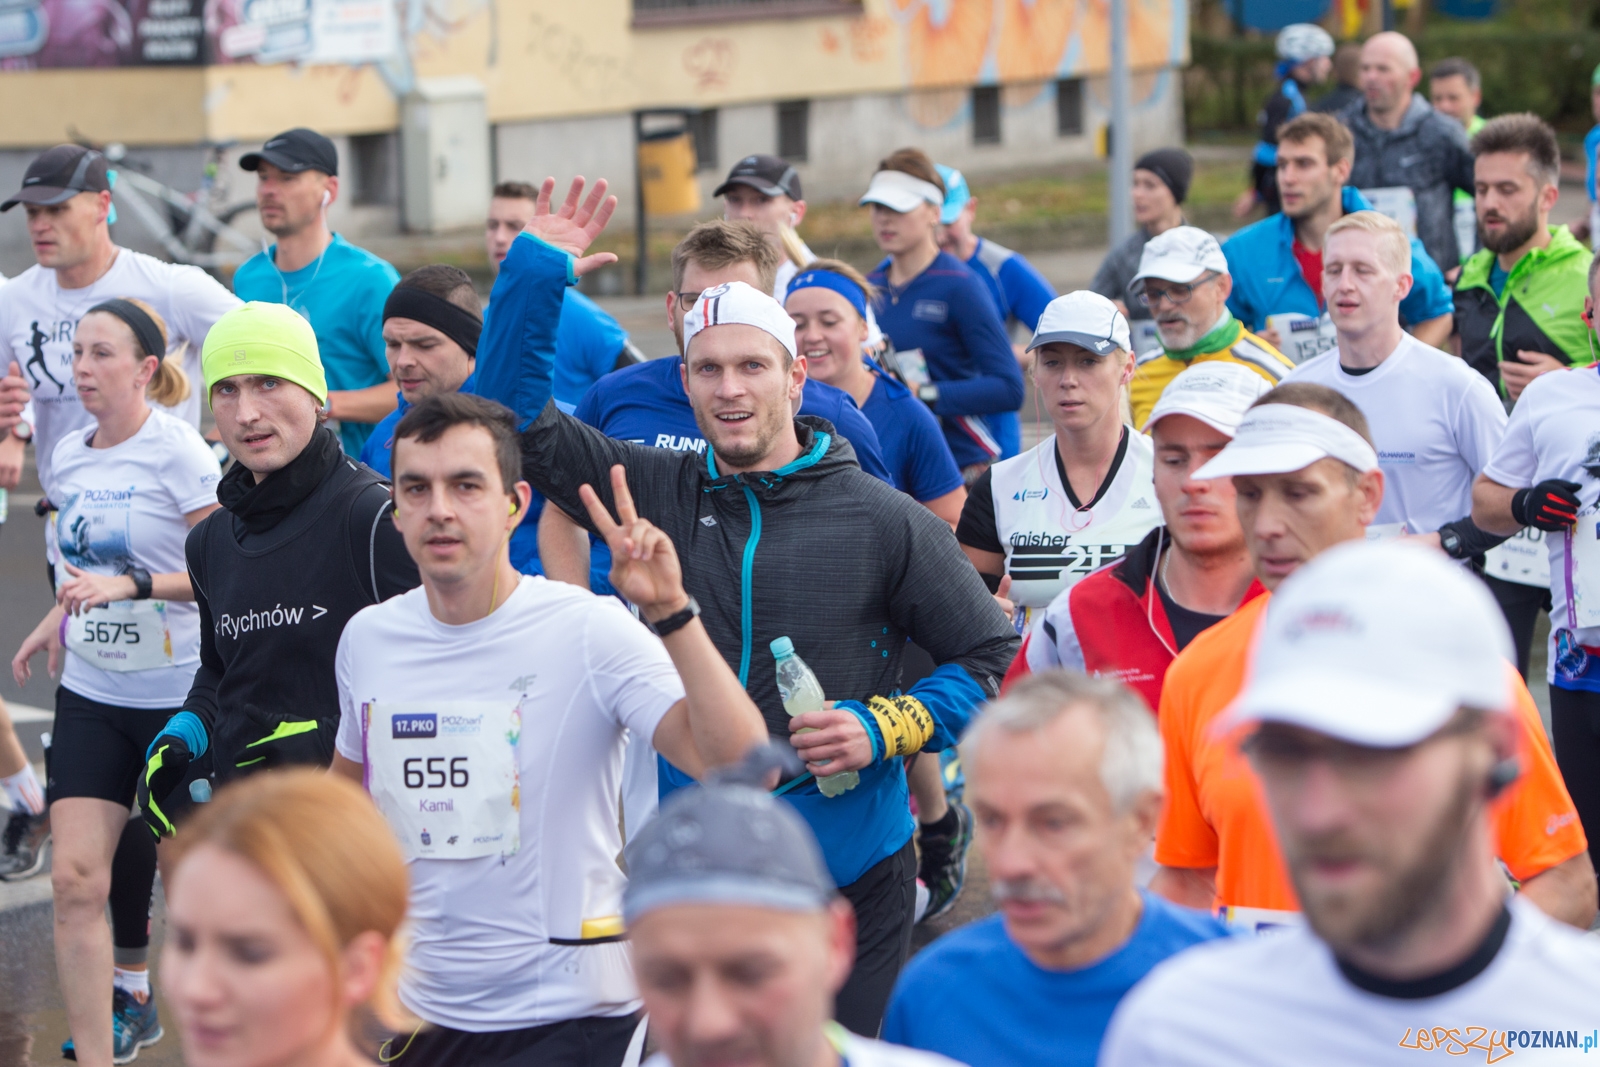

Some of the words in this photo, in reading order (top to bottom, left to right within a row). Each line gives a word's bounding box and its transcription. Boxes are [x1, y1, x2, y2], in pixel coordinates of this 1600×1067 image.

[1010, 532, 1071, 546] finisher
[221, 603, 304, 640] Rychnów
[83, 621, 140, 644] 5675
[97, 650, 127, 659] Kamila
[396, 719, 434, 733] 17.PKO
[442, 725, 480, 733] maraton
[404, 757, 469, 788] 656
[419, 799, 453, 812] Kamil
